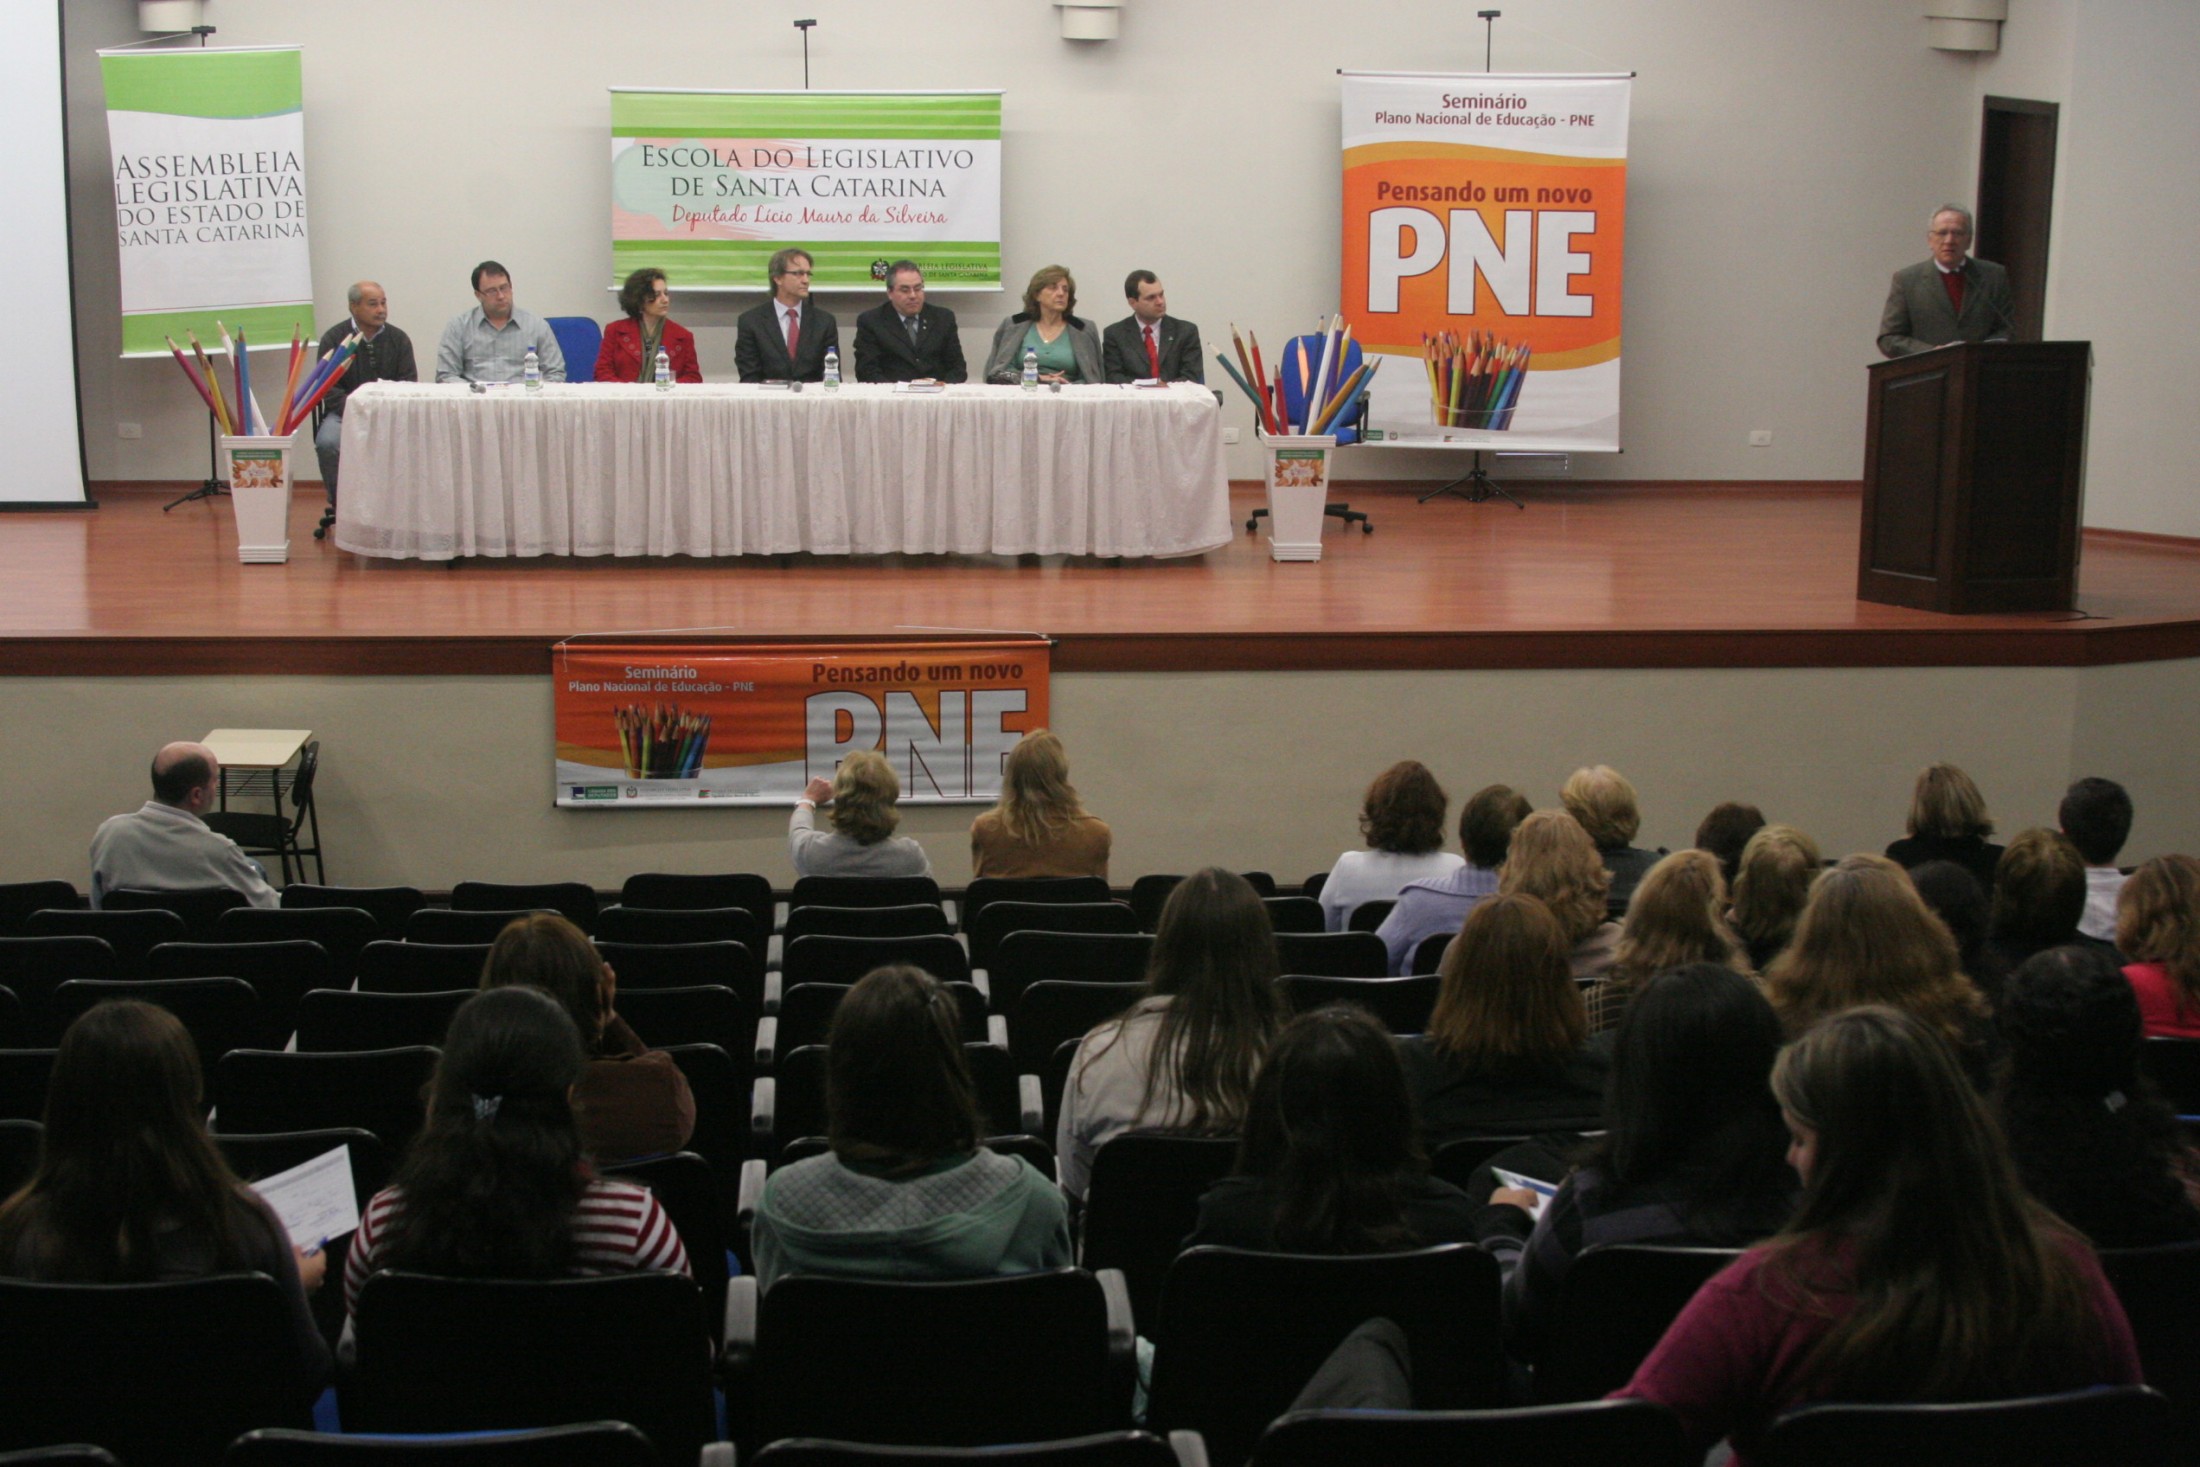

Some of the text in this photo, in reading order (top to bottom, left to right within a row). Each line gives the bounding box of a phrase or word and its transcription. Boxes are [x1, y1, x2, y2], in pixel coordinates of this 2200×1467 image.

[1441, 93, 1527, 109] Seminário
[1375, 111, 1412, 125] Plano
[1415, 112, 1472, 126] Nacional
[1475, 113, 1492, 125] de
[1496, 113, 1556, 129] Educação
[1569, 114, 1595, 126] PNE
[116, 150, 301, 180] ASSEMBLEIA
[643, 144, 974, 169] ESCOLA DO LEGISLATIVO
[116, 175, 303, 205] LEGISLATIVA
[671, 174, 946, 198] DE SANTA CATARINA
[1377, 180, 1592, 203] Pensando um novo
[119, 200, 305, 227] DO ESTADO DE
[672, 203, 948, 232] Deputado Lício Mauro da Silveira
[119, 222, 305, 247] SANTA CATARINA
[1367, 205, 1597, 318] PNE
[624, 664, 698, 680] Seminário
[812, 661, 1024, 683] Pensando um novo
[568, 681, 601, 692] Plano
[603, 680, 650, 693] Nacional
[653, 681, 669, 693] de
[671, 681, 722, 695] Educação
[733, 681, 755, 692] PNE
